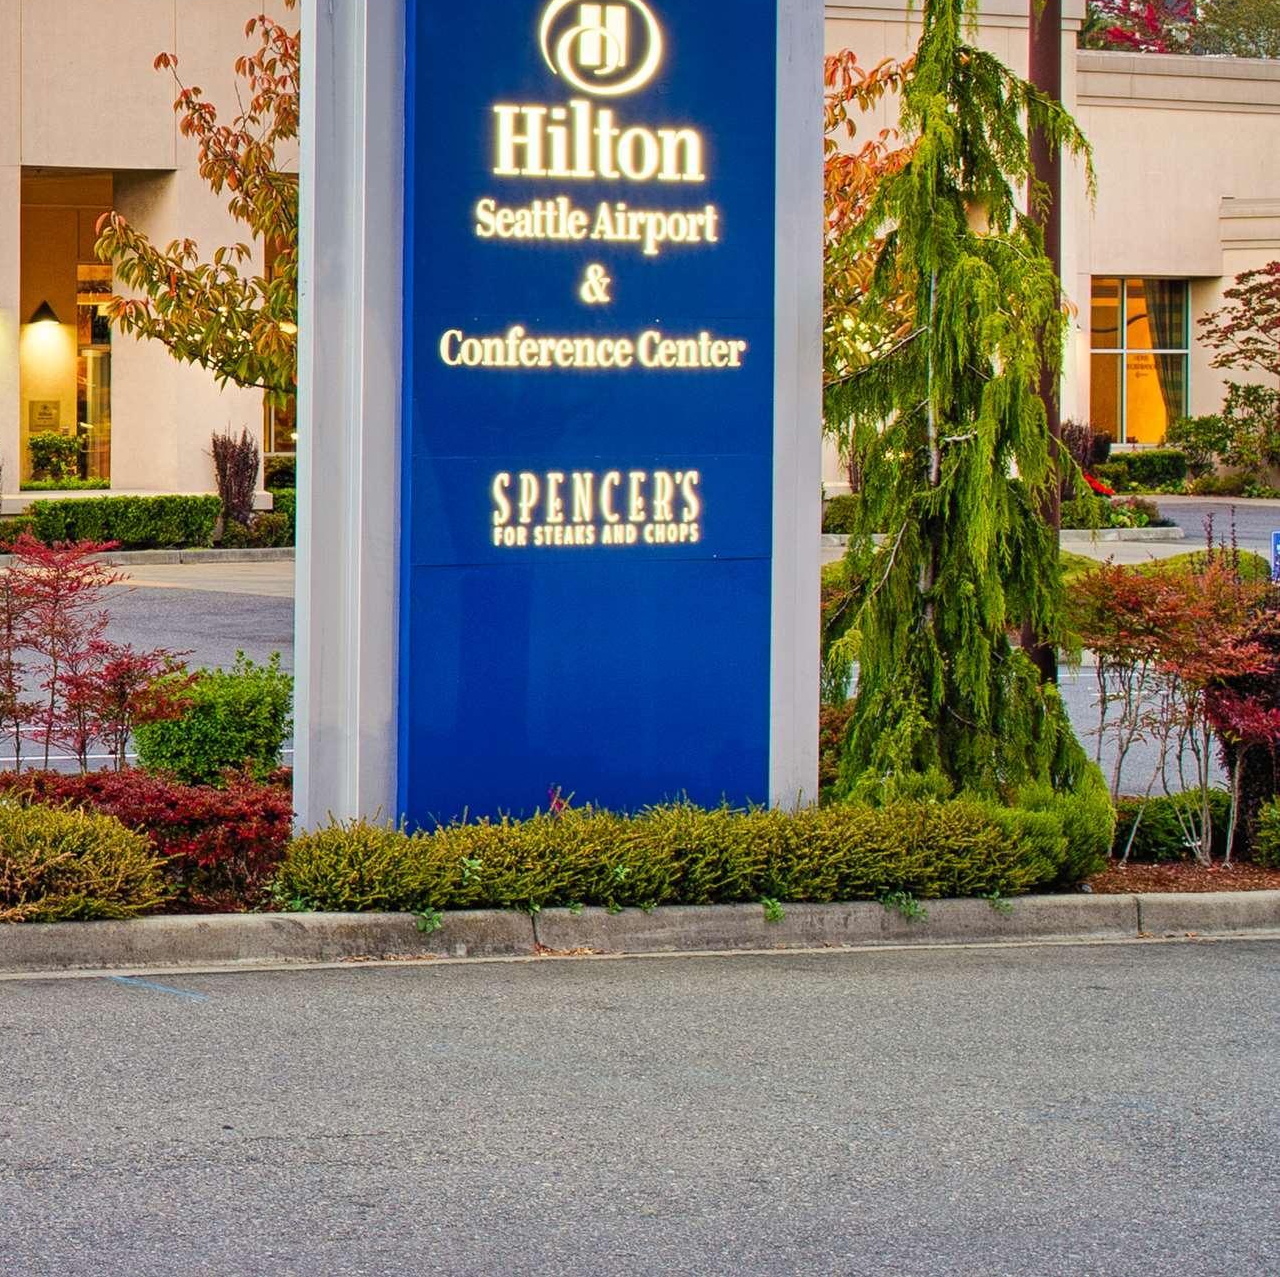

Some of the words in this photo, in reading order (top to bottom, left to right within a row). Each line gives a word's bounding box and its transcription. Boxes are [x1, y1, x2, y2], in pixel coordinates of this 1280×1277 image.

[492, 99, 706, 182] Hilton
[476, 196, 587, 241] Seattle
[591, 202, 719, 256] Airport
[579, 263, 611, 304] &
[440, 325, 633, 368] Conference
[638, 330, 747, 368] Center
[492, 471, 701, 526] SPENCER'S
[493, 525, 528, 547] FOR
[534, 525, 596, 546] STEAKS
[601, 523, 638, 545] AND
[643, 522, 700, 544] CHOPS
